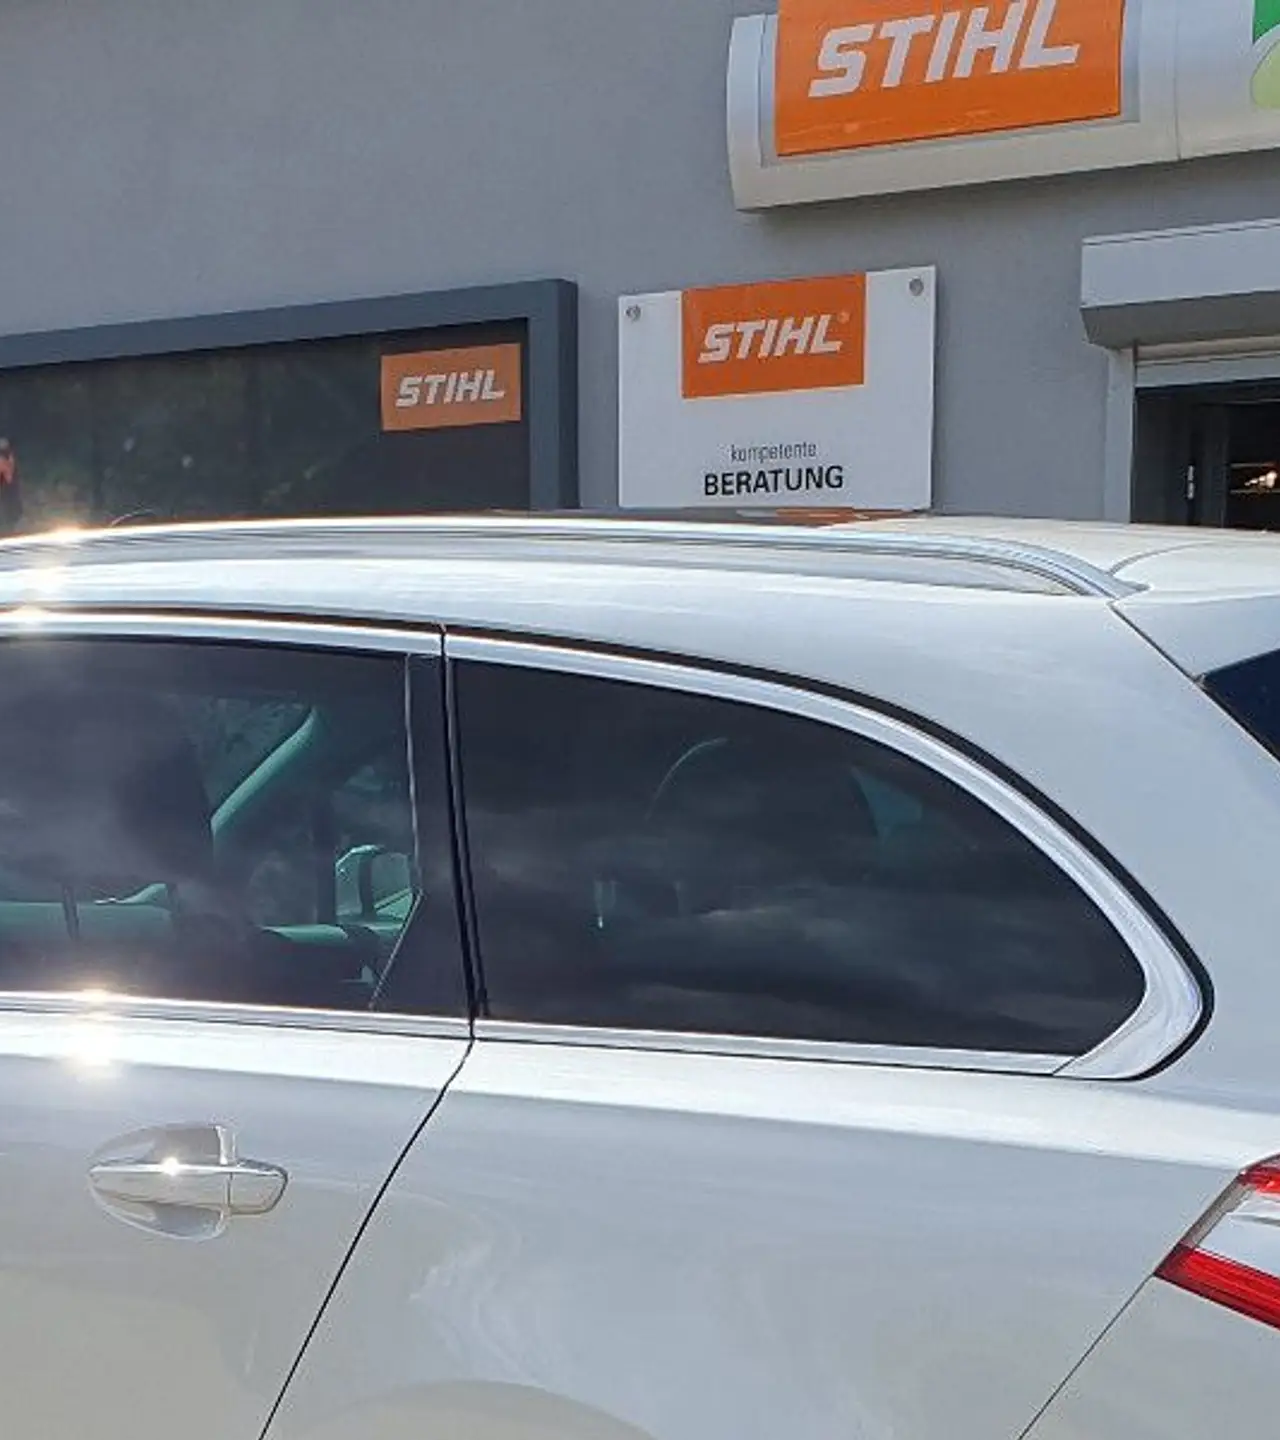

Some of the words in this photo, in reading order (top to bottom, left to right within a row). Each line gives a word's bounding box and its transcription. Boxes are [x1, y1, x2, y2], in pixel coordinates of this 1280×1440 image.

[808, 0, 1080, 98] STIHL
[698, 314, 844, 363] STIHL
[395, 369, 505, 407] STIHL
[731, 441, 817, 464] kompetente
[705, 465, 844, 496] BERATUNG
